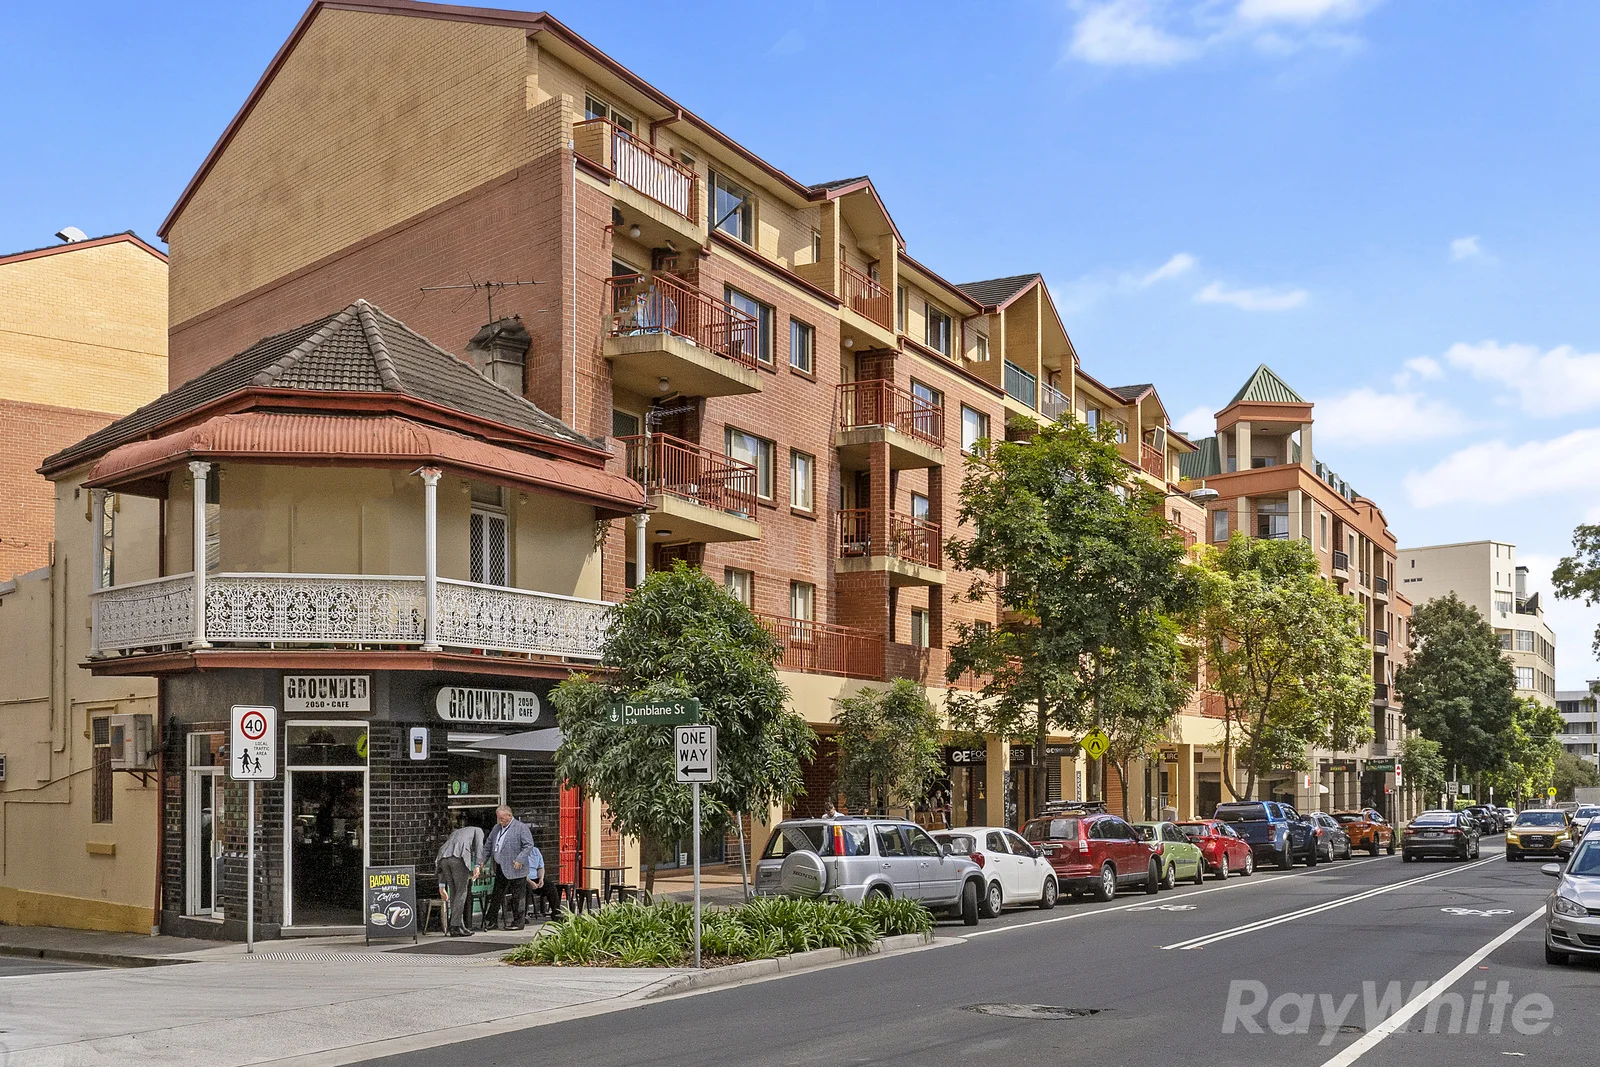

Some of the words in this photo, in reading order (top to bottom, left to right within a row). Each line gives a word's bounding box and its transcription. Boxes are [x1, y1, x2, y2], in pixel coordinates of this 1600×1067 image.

[287, 677, 367, 699] GROUNDED
[305, 700, 325, 708] 2050
[331, 700, 349, 708] CAFE
[449, 688, 515, 720] GROUNDED
[518, 697, 533, 707] 2050
[518, 707, 533, 717] CAFE
[625, 704, 672, 716] Dunblane
[674, 703, 685, 715] St
[244, 719, 263, 732] 40
[681, 731, 706, 745] ONE
[679, 748, 708, 762] WAY
[369, 874, 392, 888] BACON
[396, 873, 410, 886] EGG
[793, 870, 818, 880] HONDA
